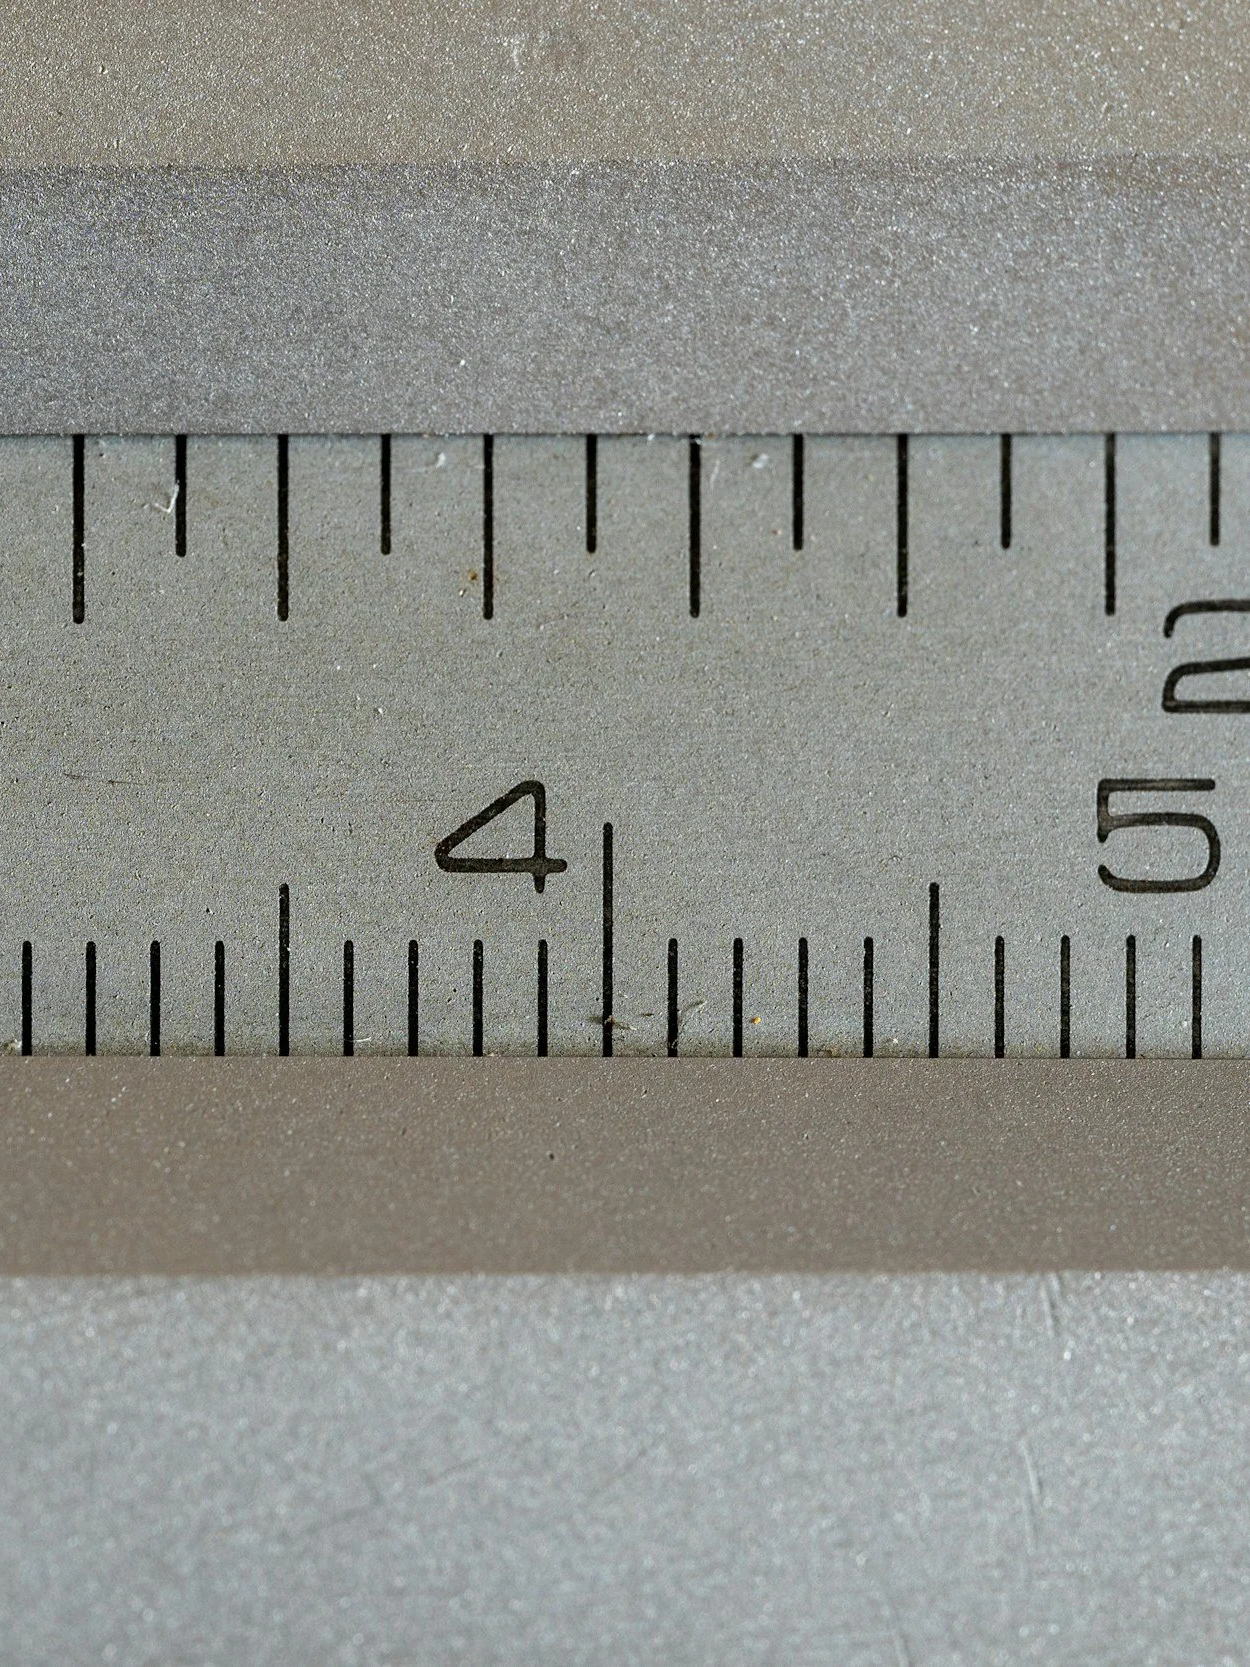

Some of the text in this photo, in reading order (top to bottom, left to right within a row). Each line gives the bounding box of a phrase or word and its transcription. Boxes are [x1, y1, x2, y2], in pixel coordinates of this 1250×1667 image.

[1161, 599, 1250, 714] 2
[435, 779, 568, 894] 4
[1097, 778, 1221, 894] 5
